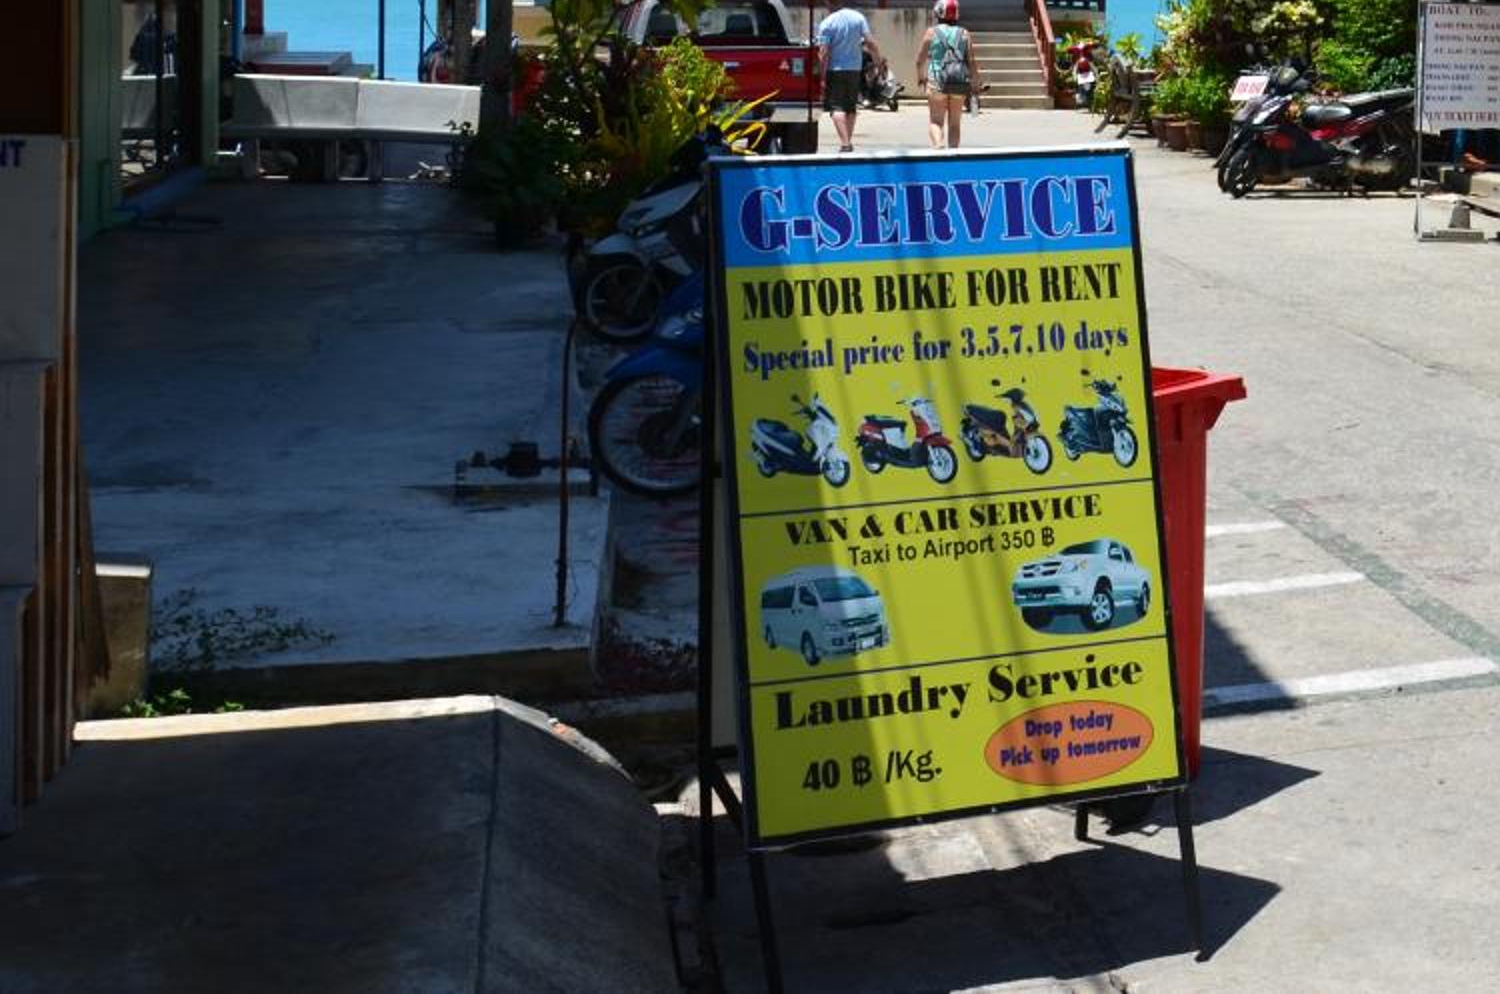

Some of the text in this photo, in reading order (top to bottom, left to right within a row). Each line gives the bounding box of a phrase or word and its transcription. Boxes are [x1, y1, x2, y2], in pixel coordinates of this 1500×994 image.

[741, 175, 1116, 254] G-SERVICE
[742, 263, 1121, 320] MOTOR BIKE FOR RENT
[743, 338, 834, 381] Special
[844, 336, 904, 375] price
[912, 331, 951, 361] for
[1074, 320, 1128, 356] days
[785, 494, 1102, 545] VAN & CAR SERVICE
[848, 542, 891, 567] Taxi
[898, 542, 917, 561] to
[923, 534, 995, 562] Airport
[1001, 529, 1035, 550] 350
[775, 654, 1143, 730] Laundry Service
[1025, 710, 1113, 738] Drop today
[802, 758, 841, 790] 40
[1000, 736, 1141, 766] Pick up tomorrow
